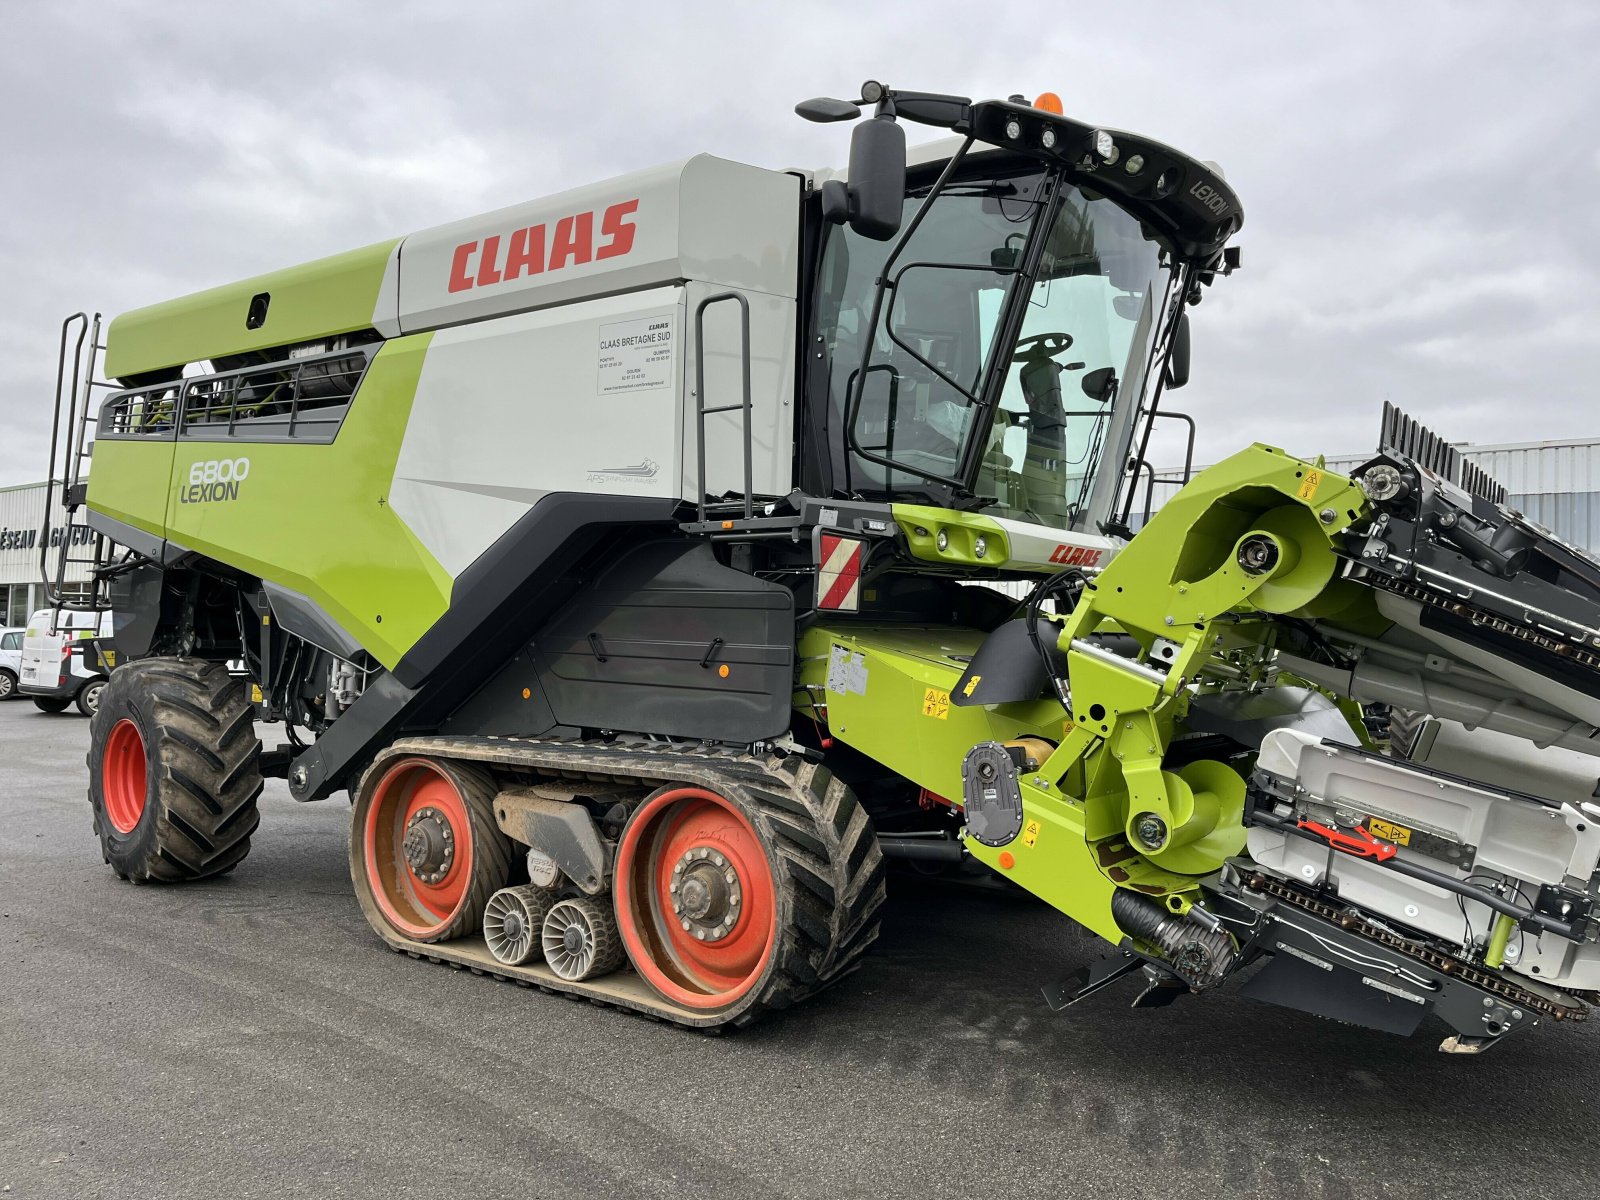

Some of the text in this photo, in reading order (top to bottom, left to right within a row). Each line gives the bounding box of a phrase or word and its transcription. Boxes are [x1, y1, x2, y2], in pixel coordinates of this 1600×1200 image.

[1190, 180, 1229, 216] LEXION
[448, 199, 639, 293] CLAAS
[648, 322, 669, 331] CLAAS
[600, 339, 620, 350] CLAAS
[621, 334, 656, 347] BRETAGNE
[657, 331, 671, 342] SUD
[189, 457, 250, 486] 6800
[181, 481, 240, 504] LEXION
[1048, 544, 1103, 567] CLAAS
